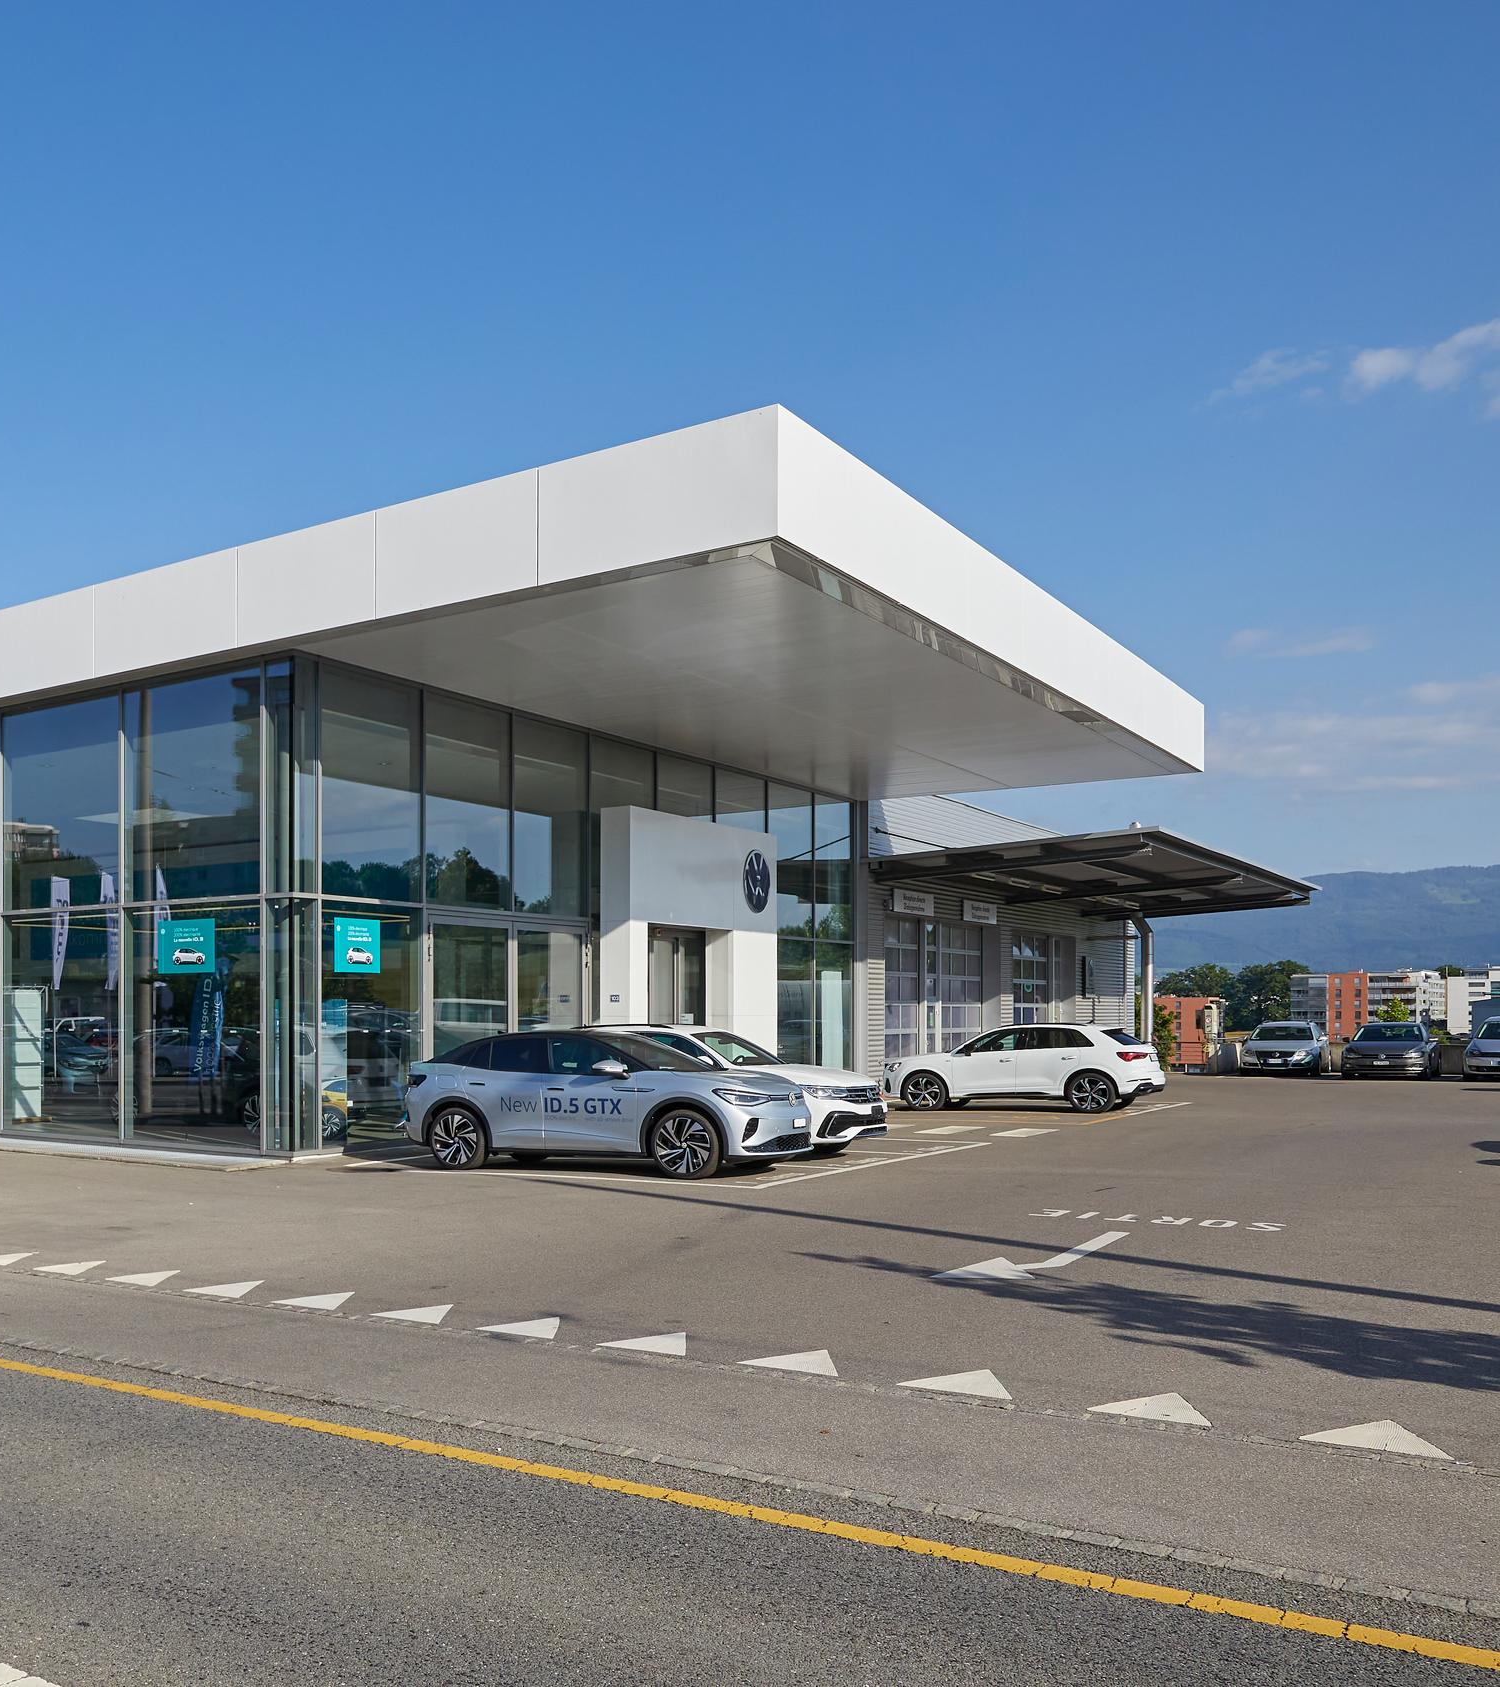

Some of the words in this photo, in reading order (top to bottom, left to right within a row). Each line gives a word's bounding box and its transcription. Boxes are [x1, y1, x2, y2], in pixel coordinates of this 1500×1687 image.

[194, 1001, 210, 1072] Volkswagen
[500, 1097, 538, 1113] New
[544, 1097, 579, 1114] ID.5
[583, 1098, 622, 1115] GTX
[1028, 1208, 1287, 1232] SORTIE
